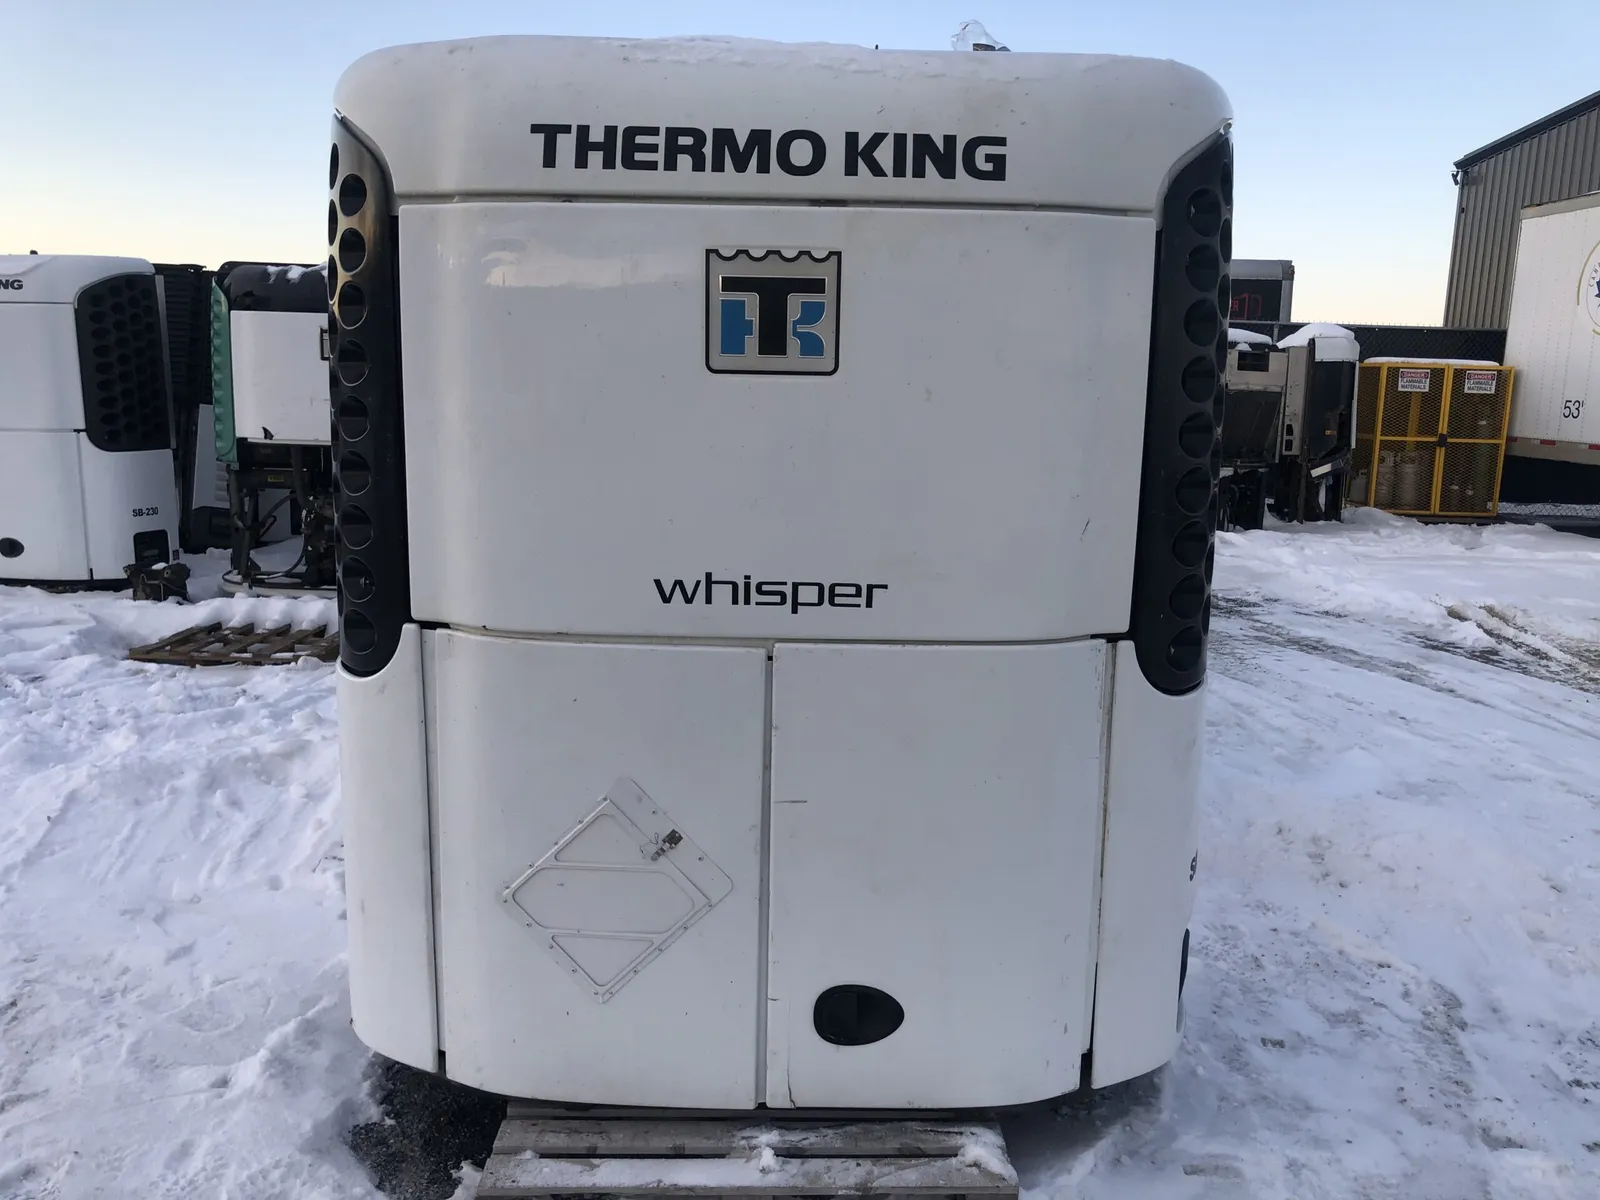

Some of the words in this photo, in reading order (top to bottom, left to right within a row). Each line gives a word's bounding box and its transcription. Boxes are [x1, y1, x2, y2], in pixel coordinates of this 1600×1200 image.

[530, 123, 827, 177] THERMO
[844, 131, 1008, 182] KING
[132, 506, 159, 517] SB-230
[653, 571, 889, 615] whisper
